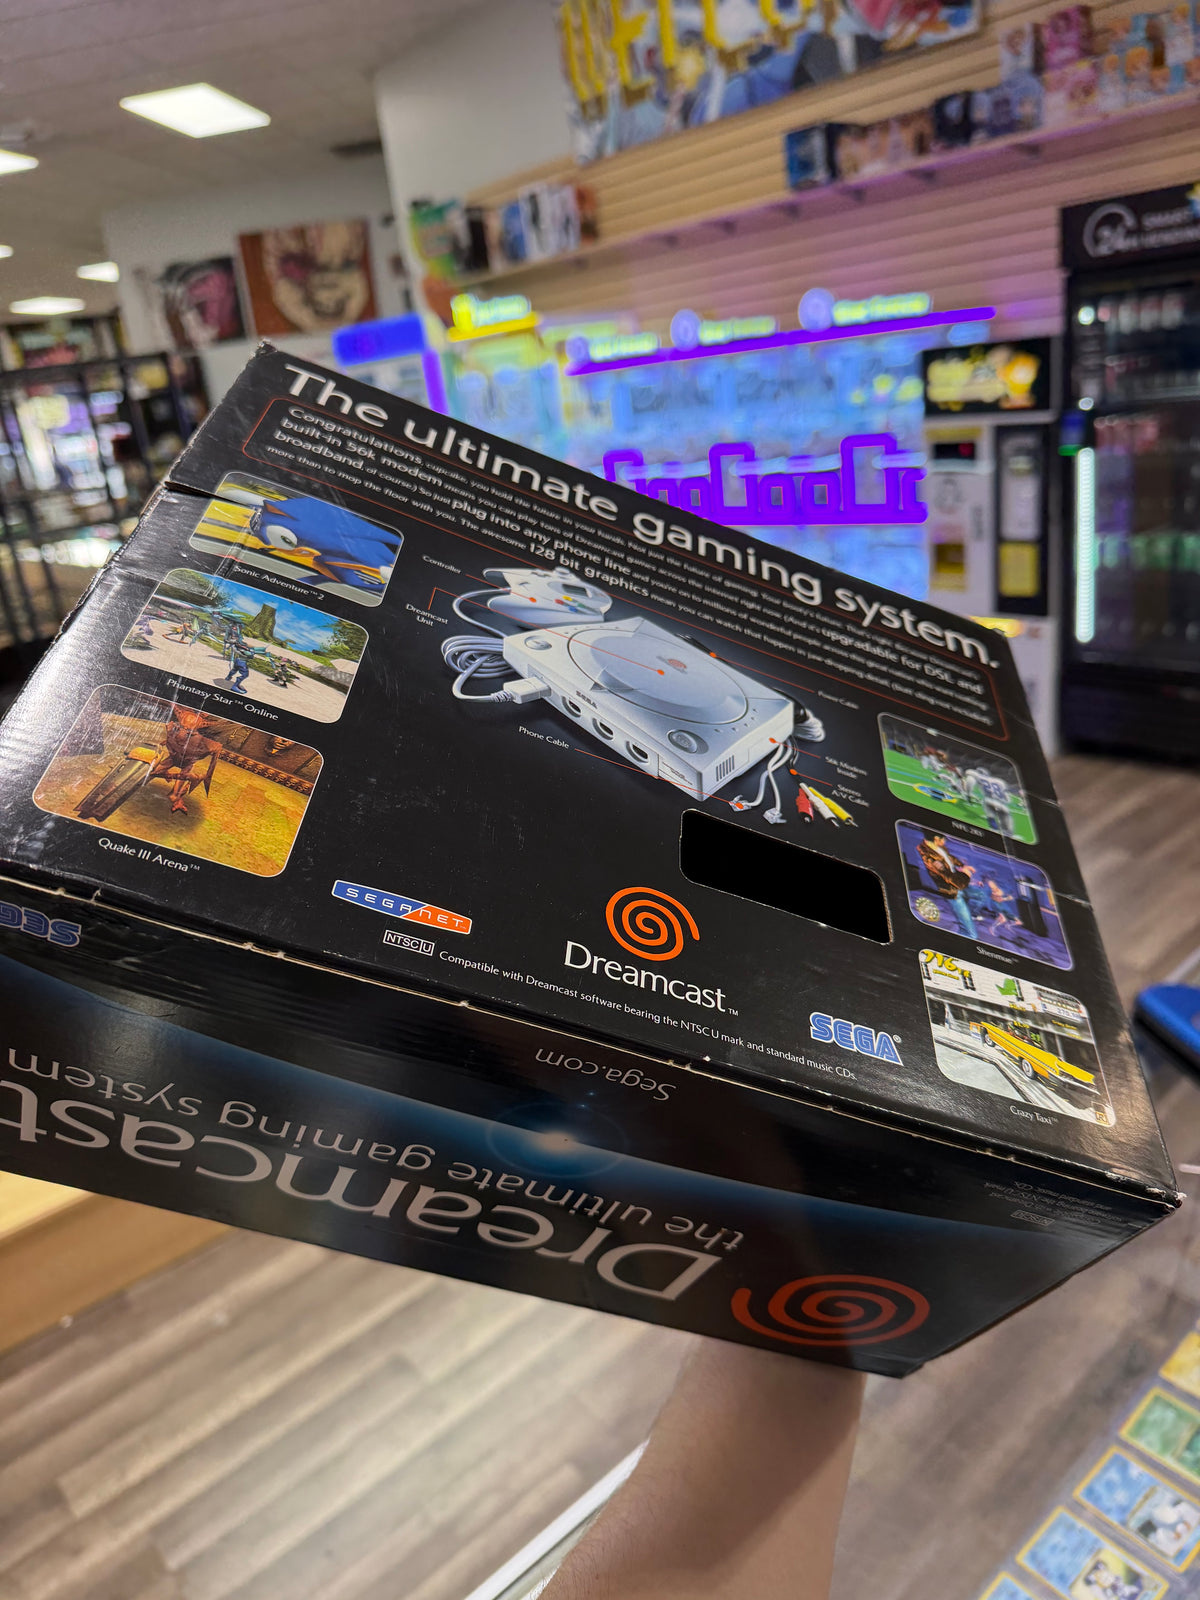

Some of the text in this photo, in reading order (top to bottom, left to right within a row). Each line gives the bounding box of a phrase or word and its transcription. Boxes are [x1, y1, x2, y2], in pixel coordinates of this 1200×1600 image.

[284, 363, 1000, 671] The ultimate gaming system.
[286, 406, 425, 466] Congratulations,
[470, 479, 490, 493] you
[490, 485, 513, 501] hold
[514, 495, 531, 508] the
[533, 502, 561, 520] future
[563, 514, 573, 525] in
[575, 520, 595, 535] your
[667, 554, 681, 567] the
[684, 560, 710, 578] future
[712, 571, 722, 583] of
[267, 445, 295, 460] more
[297, 455, 322, 469] than
[322, 465, 336, 474] to
[336, 471, 362, 486] mop
[363, 480, 382, 492] the
[383, 487, 409, 503] floor
[411, 498, 434, 513] with
[435, 509, 457, 523] you.
[460, 518, 479, 531] The
[481, 528, 526, 550] awesome
[529, 541, 555, 561] 128
[559, 553, 580, 570] bit
[584, 564, 648, 599] graphics
[651, 592, 675, 607] mean
[678, 603, 695, 616] you
[698, 610, 713, 621] can
[716, 616, 740, 632] watch
[744, 626, 761, 640] that
[764, 634, 795, 653] happen
[797, 647, 806, 656] in
[273, 428, 366, 471] broadband,
[366, 466, 377, 475] of
[419, 486, 432, 497] So
[433, 492, 450, 505] just
[451, 497, 488, 521] plug
[490, 512, 521, 532] into
[523, 526, 550, 547] any
[554, 536, 601, 566] phone
[605, 556, 630, 575] line
[632, 569, 649, 583] and
[651, 577, 677, 594] you're
[679, 589, 690, 598] on
[692, 593, 701, 603] to
[703, 596, 736, 616] millions
[739, 610, 748, 620] of
[749, 614, 792, 637] wonderful
[280, 415, 344, 447] built-in
[345, 440, 377, 460] 56k
[380, 454, 444, 487] modem
[444, 483, 476, 500] means
[478, 497, 496, 510] you
[499, 505, 516, 516] can
[517, 511, 538, 526] play
[540, 520, 561, 534] tons
[563, 528, 573, 538] of
[575, 533, 624, 559] Dreamcast
[627, 554, 656, 573] games
[658, 566, 686, 583] across
[689, 576, 702, 589] the
[740, 596, 761, 613] right
[822, 624, 899, 666] upgradable
[899, 653, 923, 673] for
[923, 662, 953, 684] DSL
[955, 674, 984, 696] and
[233, 564, 262, 581] Sonic
[317, 592, 325, 602] 2
[421, 554, 462, 576] Controller
[404, 602, 448, 626] Dreamcast
[416, 614, 434, 627] Unit
[166, 678, 211, 703] Phantasy
[244, 702, 280, 722] Online
[518, 725, 570, 750] Phone Cable
[98, 836, 136, 860] Quake
[138, 846, 151, 862] III
[386, 932, 432, 952] NTSC U
[439, 950, 858, 1082] Compatible with Dreamcast software bearing the NTSC U mark and standard music CDs.
[535, 1047, 677, 1102] Sega.com
[1010, 1104, 1034, 1122] Crazy
[8, 1048, 744, 1253] the ultimate gaming system
[0, 1080, 722, 1301] Dreamcast
